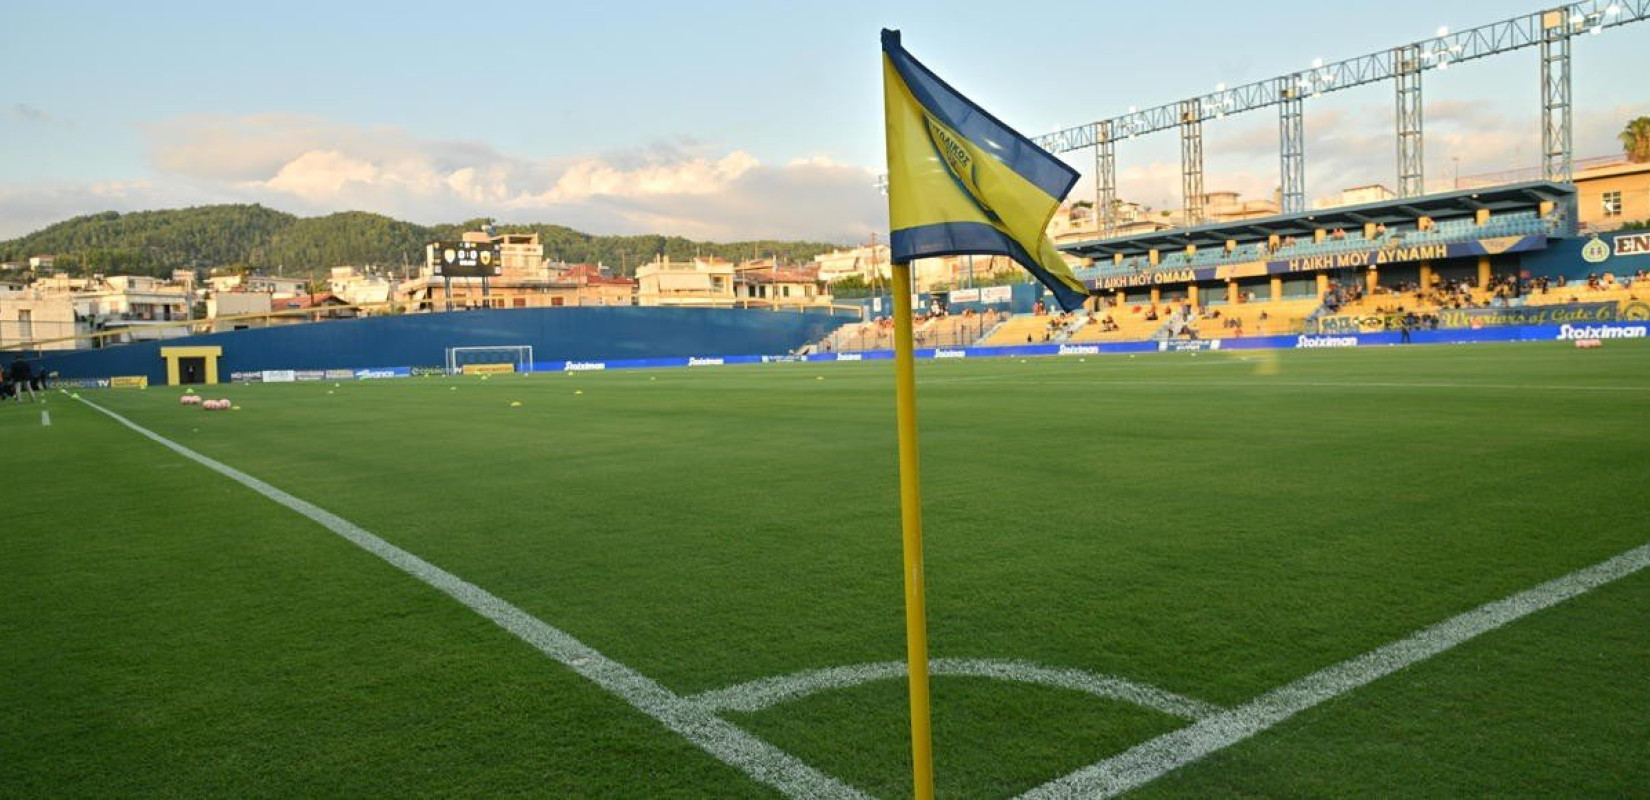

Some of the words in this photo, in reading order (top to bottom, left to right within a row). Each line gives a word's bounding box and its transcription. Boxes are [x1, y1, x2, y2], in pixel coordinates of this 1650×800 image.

[1289, 258, 1299, 271] Η
[1302, 254, 1334, 270] ΔΙΚΗ
[1337, 252, 1370, 267] ΜΟΥ
[1376, 244, 1447, 263] ΔΥΝΑΜΗ
[1095, 277, 1103, 288] Η
[1104, 275, 1127, 289] ΔΙΚΗ
[1154, 270, 1195, 284] ΟΜΑΔΑ
[1556, 323, 1647, 340] Stoiximan
[1296, 334, 1358, 348] Stoiximan
